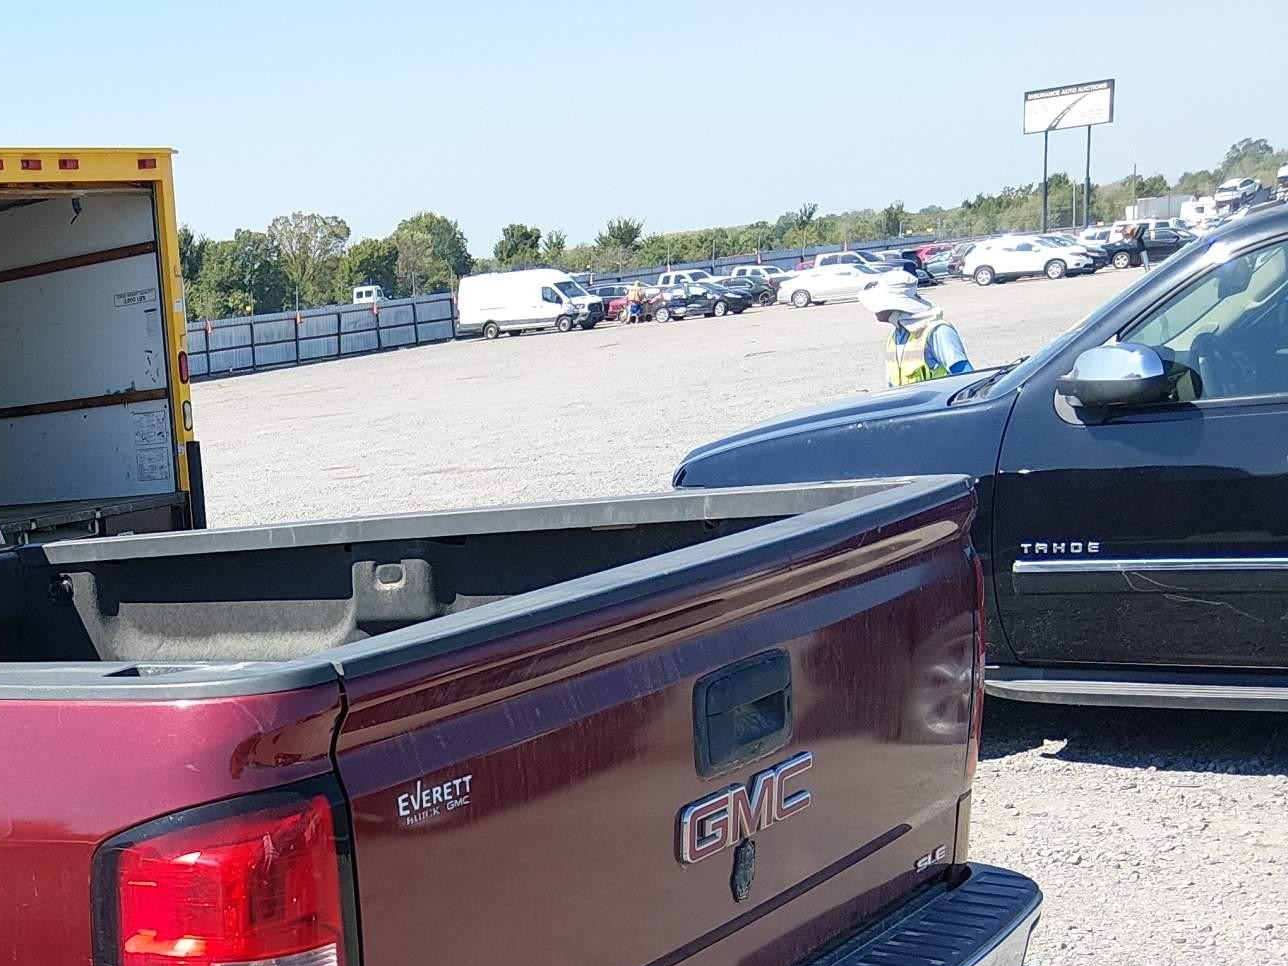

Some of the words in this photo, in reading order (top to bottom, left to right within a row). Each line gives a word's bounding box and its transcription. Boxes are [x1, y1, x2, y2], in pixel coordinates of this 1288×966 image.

[1020, 541, 1100, 554] TAHOE
[397, 774, 473, 817] EVERETT
[446, 795, 471, 811] GMC
[681, 751, 813, 864] GMC
[915, 844, 946, 873] SLE
